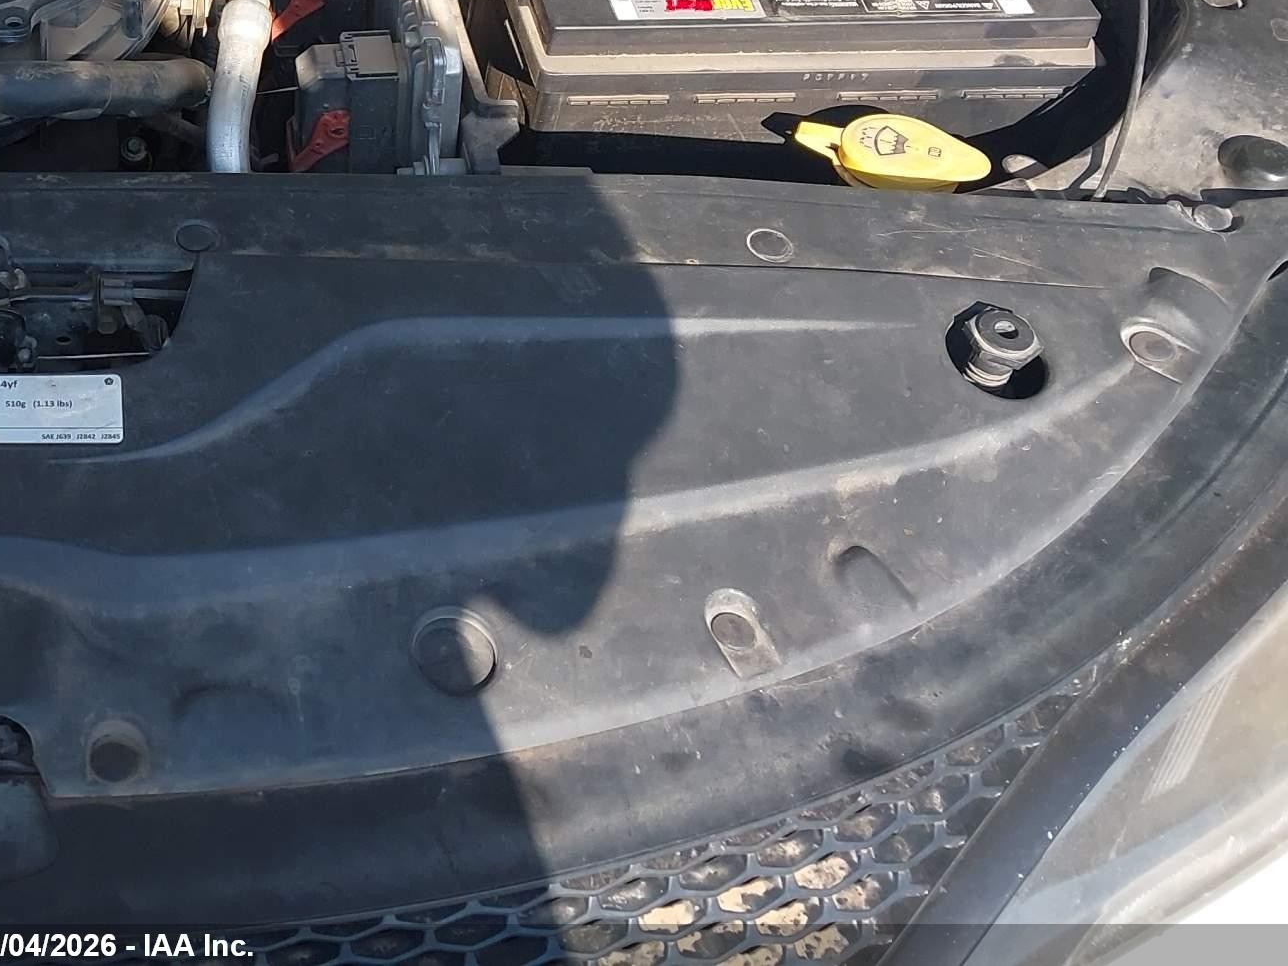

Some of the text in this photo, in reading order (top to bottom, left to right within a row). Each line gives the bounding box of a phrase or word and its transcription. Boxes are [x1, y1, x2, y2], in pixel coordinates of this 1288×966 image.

[5, 400, 73, 409] 510g (1.13 lbs)
